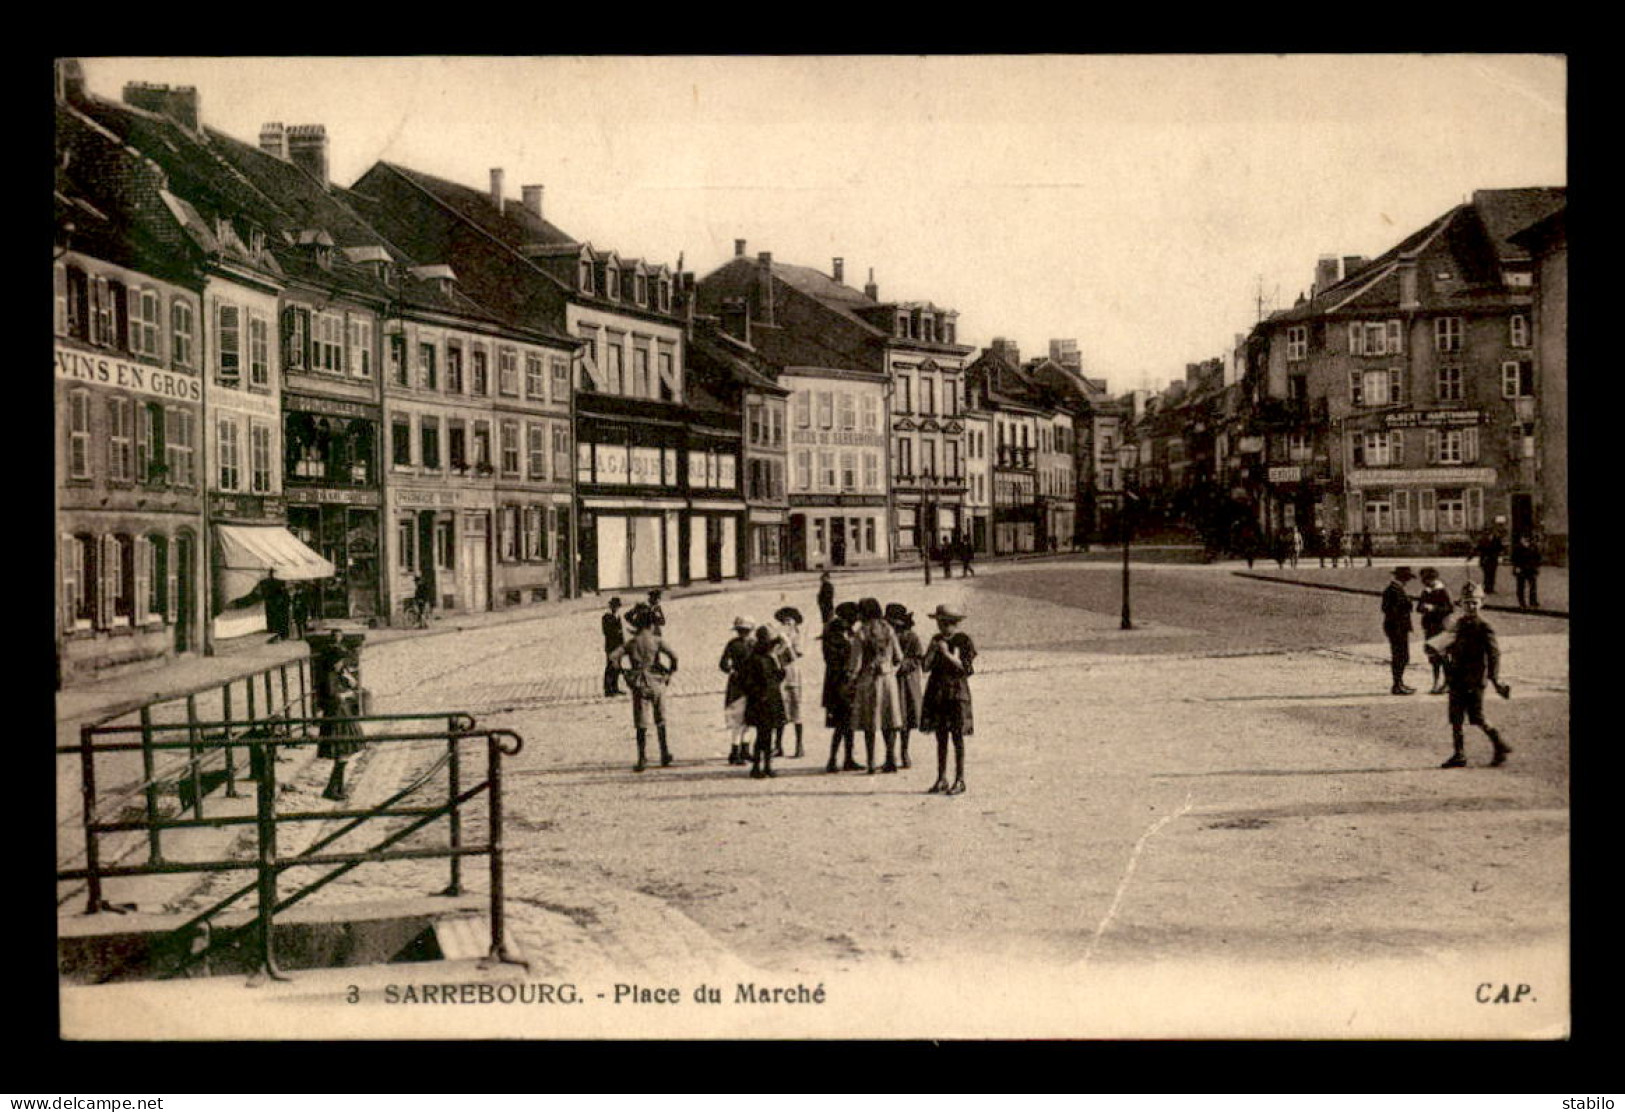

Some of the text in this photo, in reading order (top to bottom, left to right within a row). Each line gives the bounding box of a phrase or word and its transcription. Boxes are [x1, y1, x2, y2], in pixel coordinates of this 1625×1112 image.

[56, 351, 201, 401] VINS EN GROS
[578, 451, 673, 476] MAGASINS
